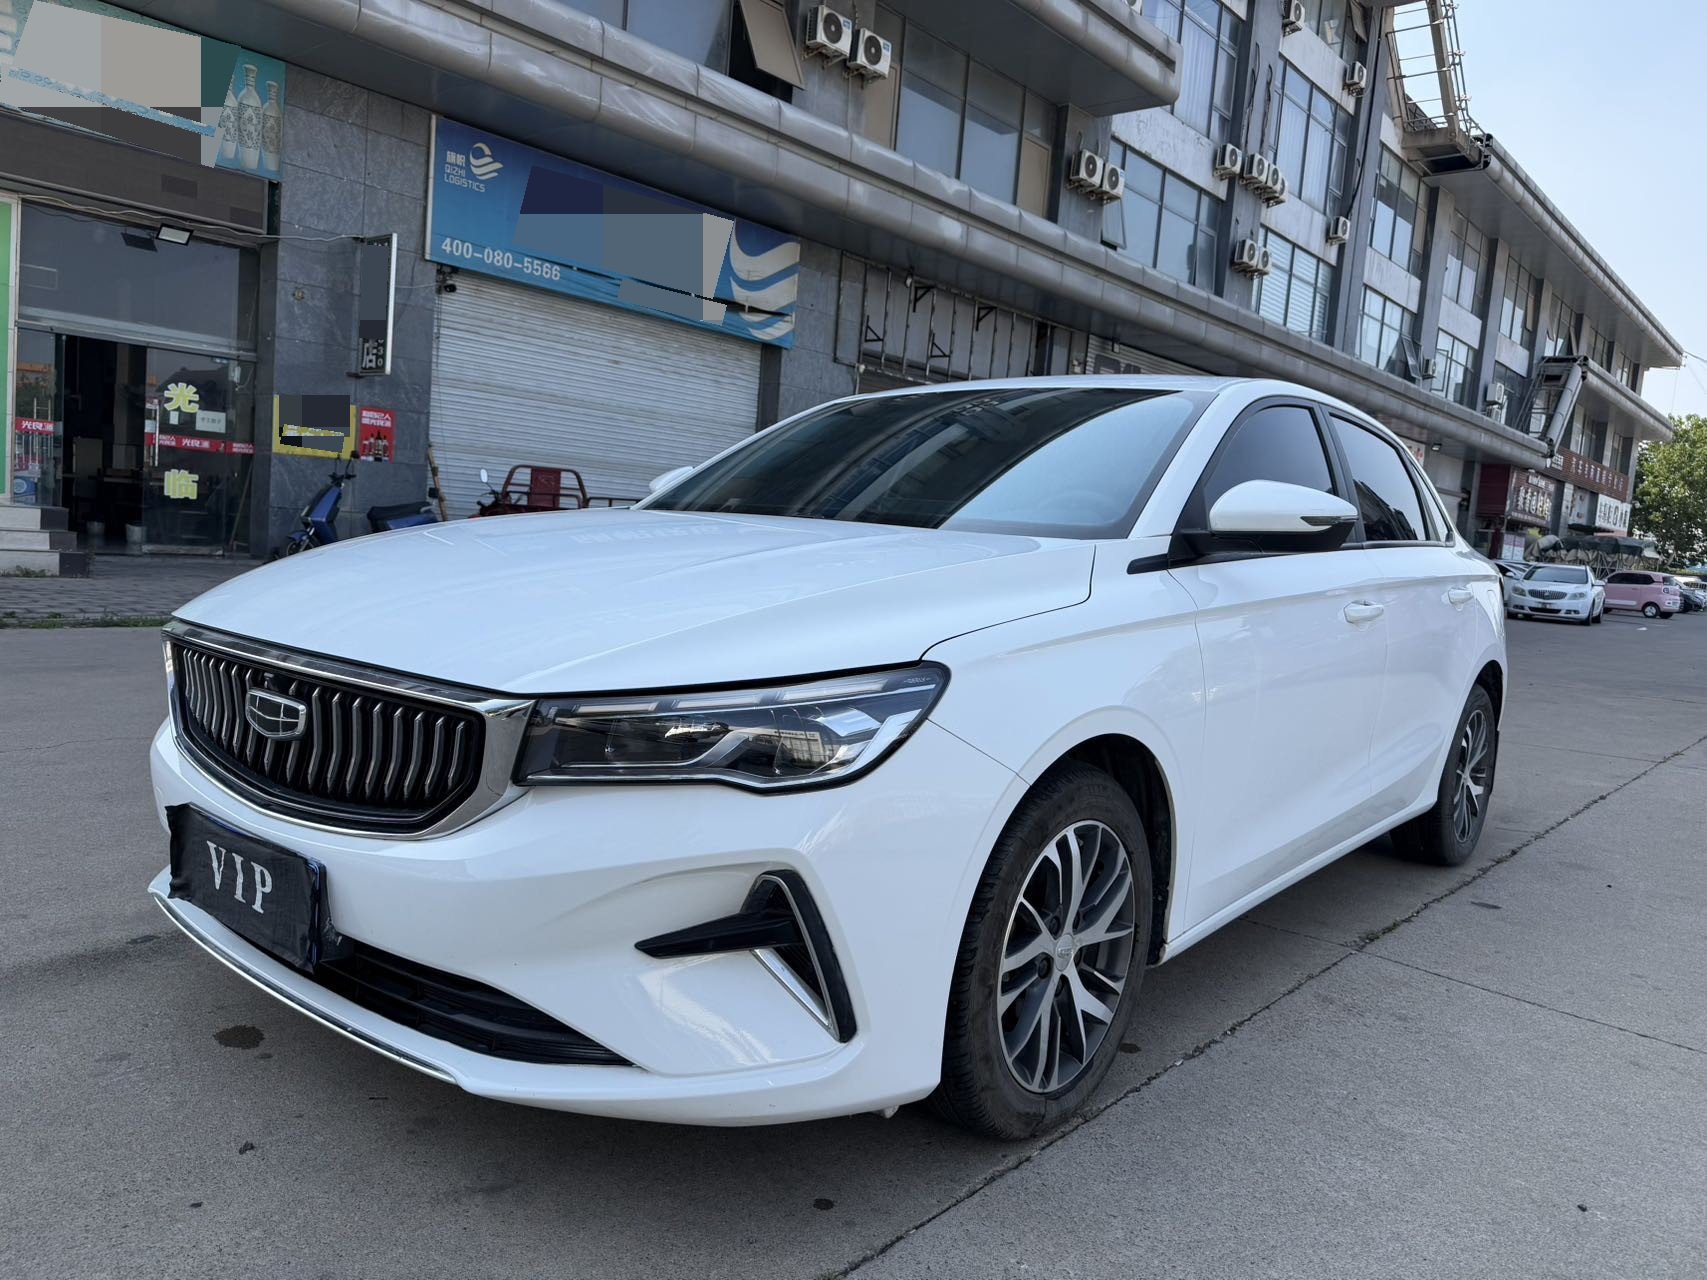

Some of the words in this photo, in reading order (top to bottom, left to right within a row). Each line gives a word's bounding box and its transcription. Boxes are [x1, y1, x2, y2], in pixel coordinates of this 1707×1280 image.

[444, 173, 485, 192] LOGISTICS
[445, 164, 465, 177] QIZHI
[441, 237, 561, 280] 400-080-5566
[206, 840, 273, 914] VIP
